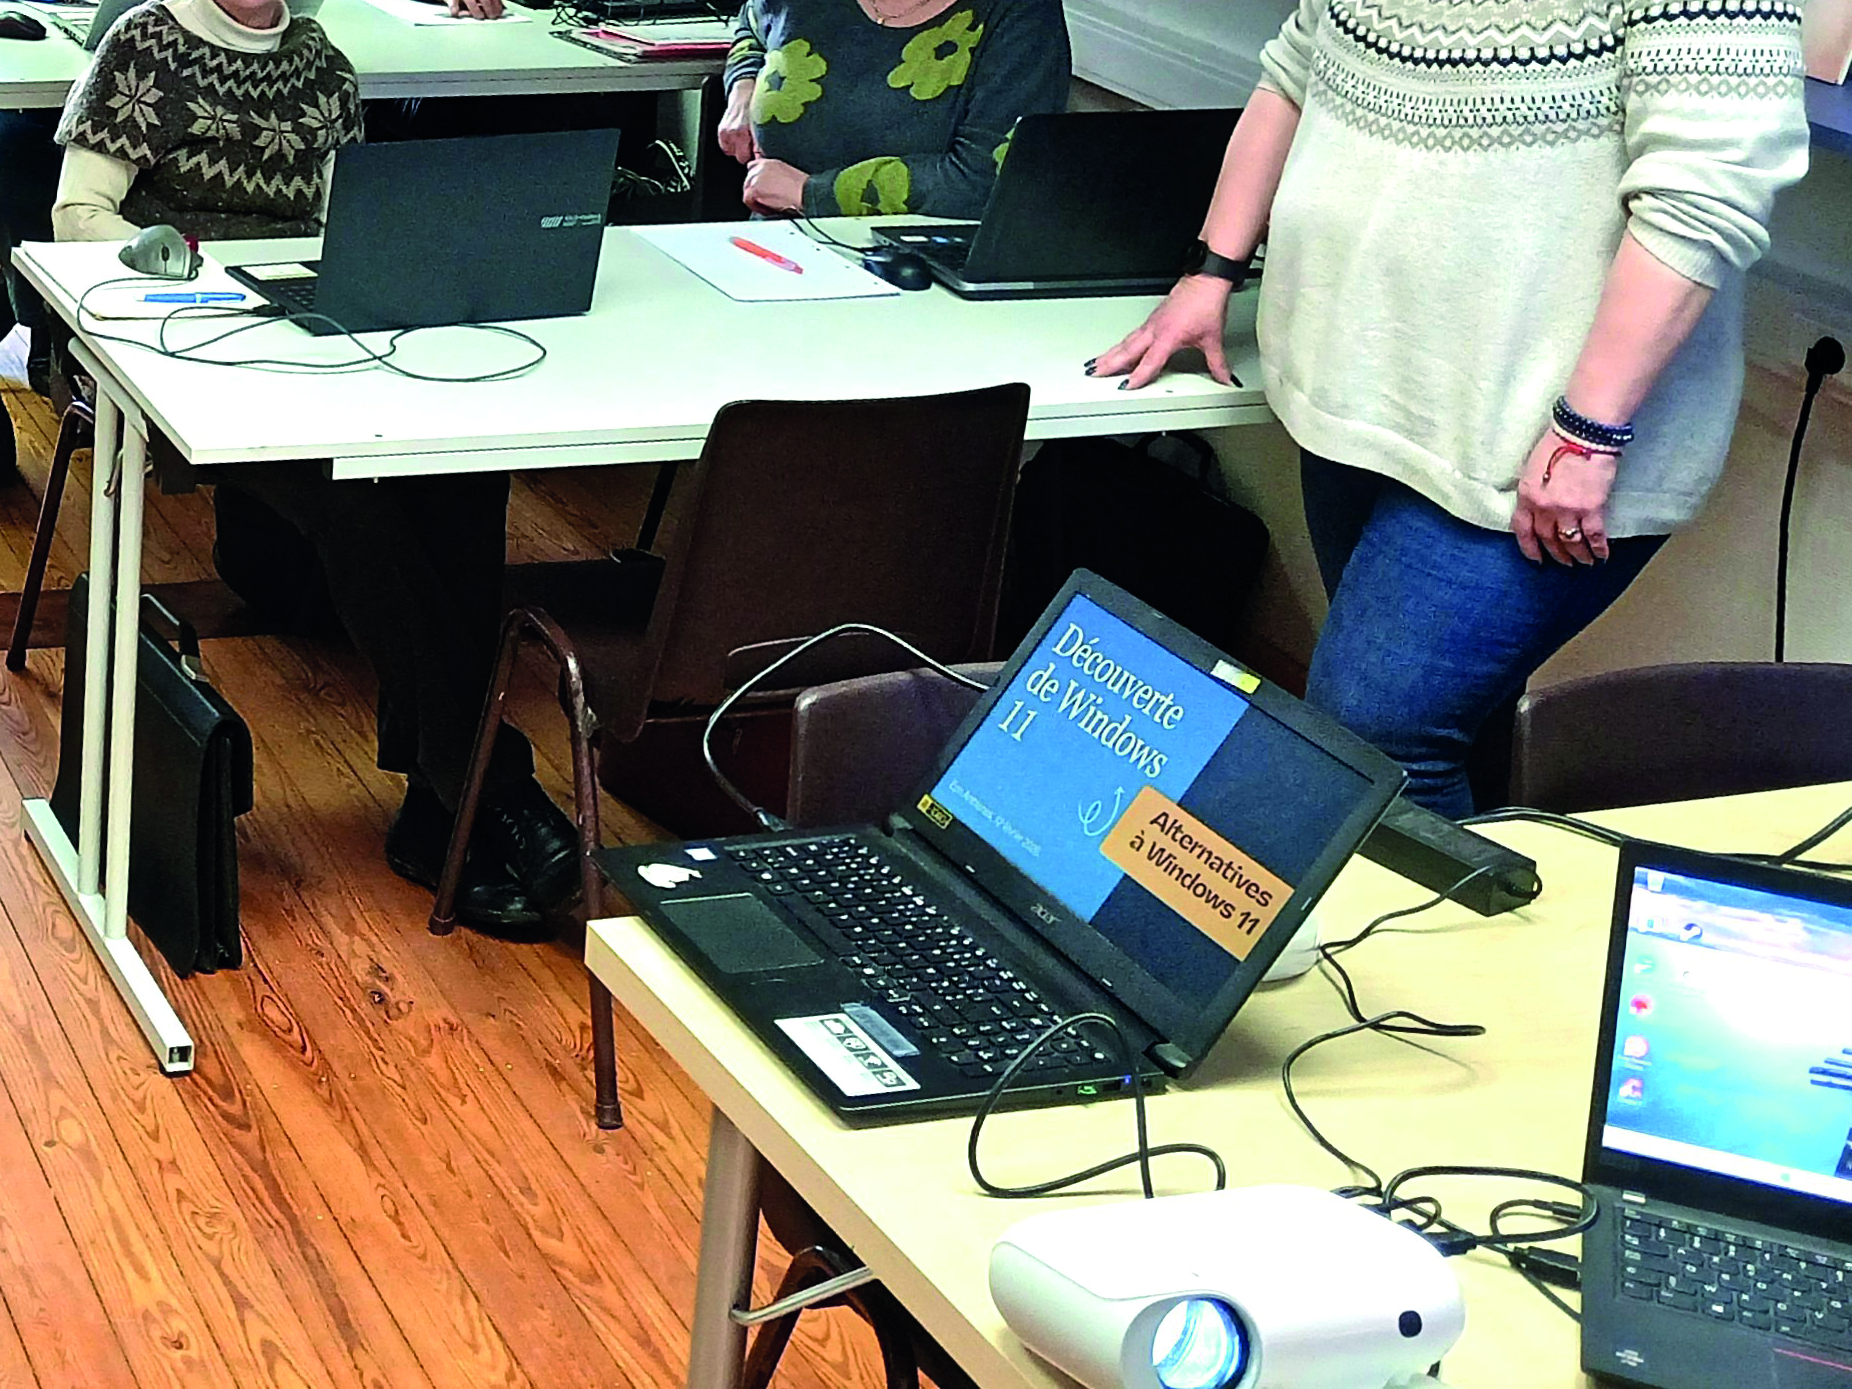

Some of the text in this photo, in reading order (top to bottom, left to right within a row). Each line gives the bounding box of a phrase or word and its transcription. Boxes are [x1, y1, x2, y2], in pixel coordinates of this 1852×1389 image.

[998, 700, 1032, 742] 11
[1026, 662, 1169, 779] de Windows
[1052, 623, 1185, 730] Découverte
[1129, 830, 1261, 937] à Windows 11
[1149, 810, 1273, 908] Alternatives
